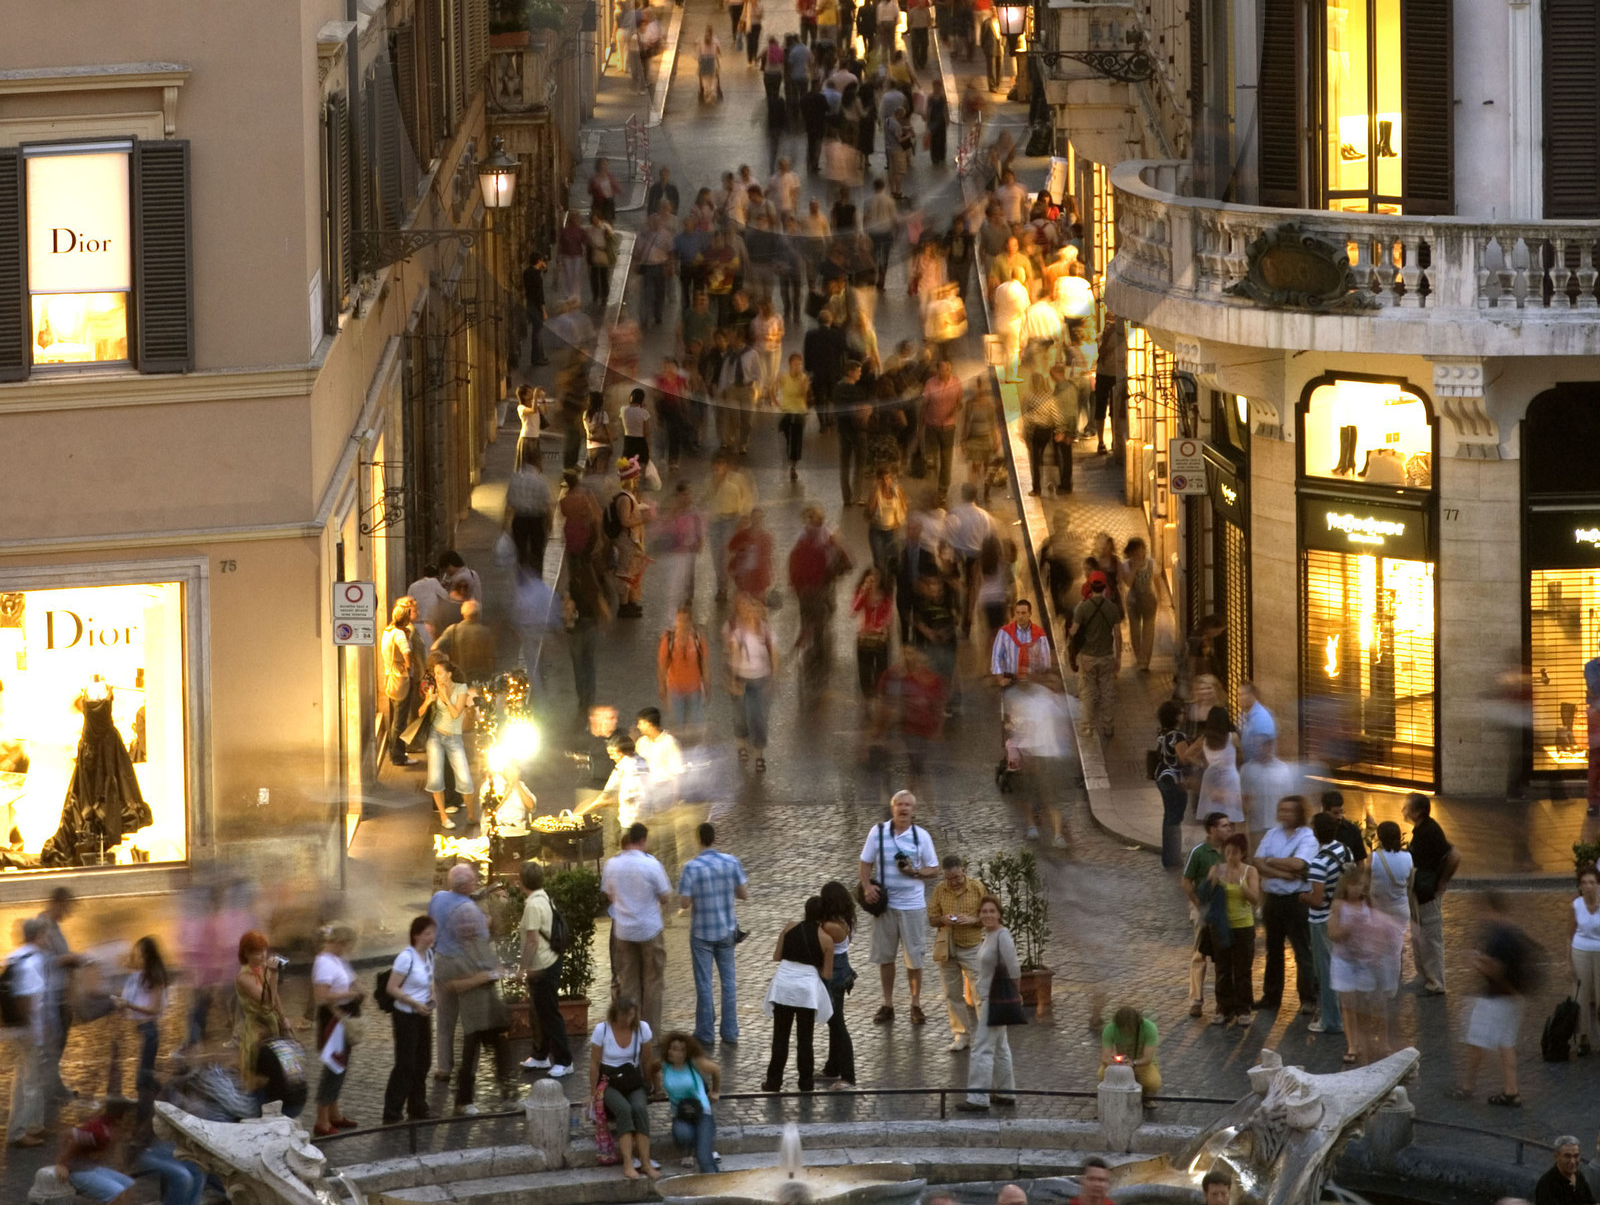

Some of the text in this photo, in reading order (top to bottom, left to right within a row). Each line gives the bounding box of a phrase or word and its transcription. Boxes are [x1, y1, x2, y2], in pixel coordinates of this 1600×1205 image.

[48, 227, 112, 254] Dior
[1443, 508, 1460, 522] 77
[219, 559, 237, 573] 75
[45, 610, 138, 650] Dior
